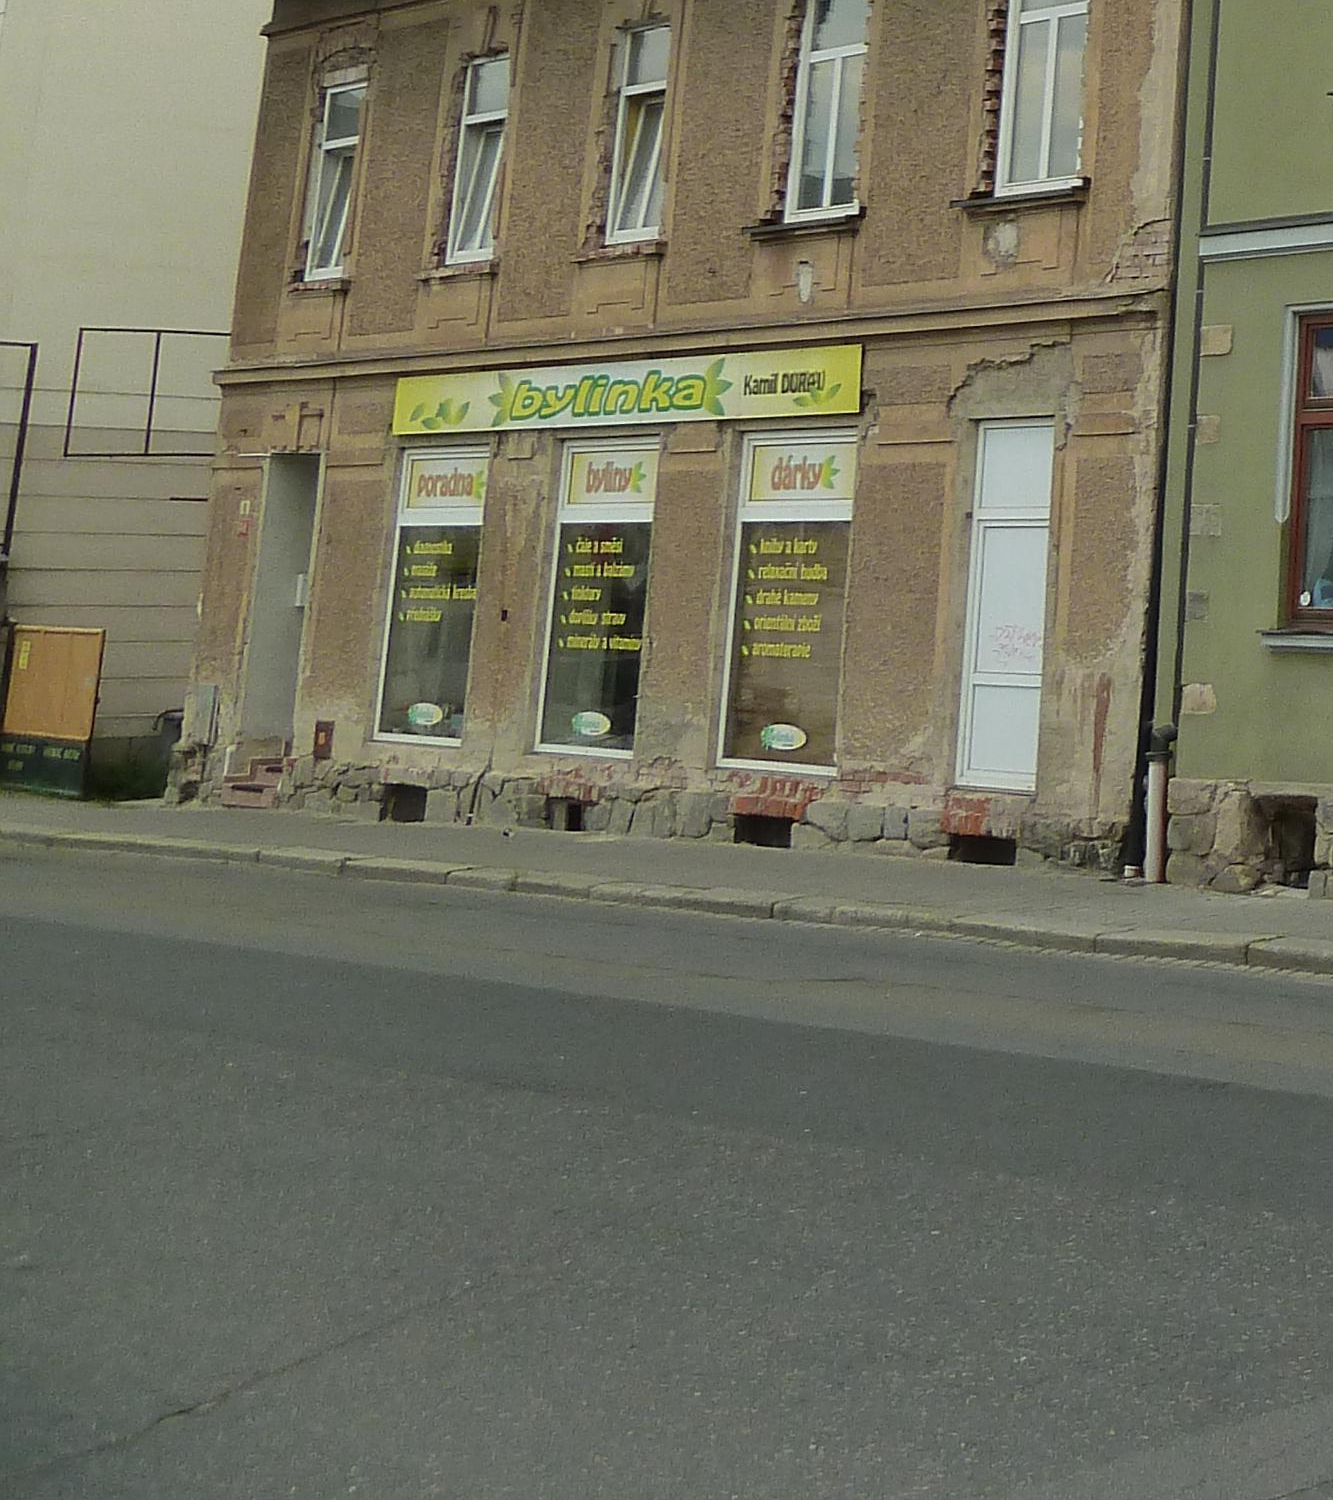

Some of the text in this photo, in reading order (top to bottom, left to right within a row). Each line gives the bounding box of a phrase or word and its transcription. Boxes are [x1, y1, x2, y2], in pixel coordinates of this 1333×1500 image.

[510, 370, 707, 421] bylinka
[743, 373, 779, 396] Kamil
[417, 466, 474, 498] poradna
[584, 460, 634, 494] byliny
[771, 454, 823, 490] dárky
